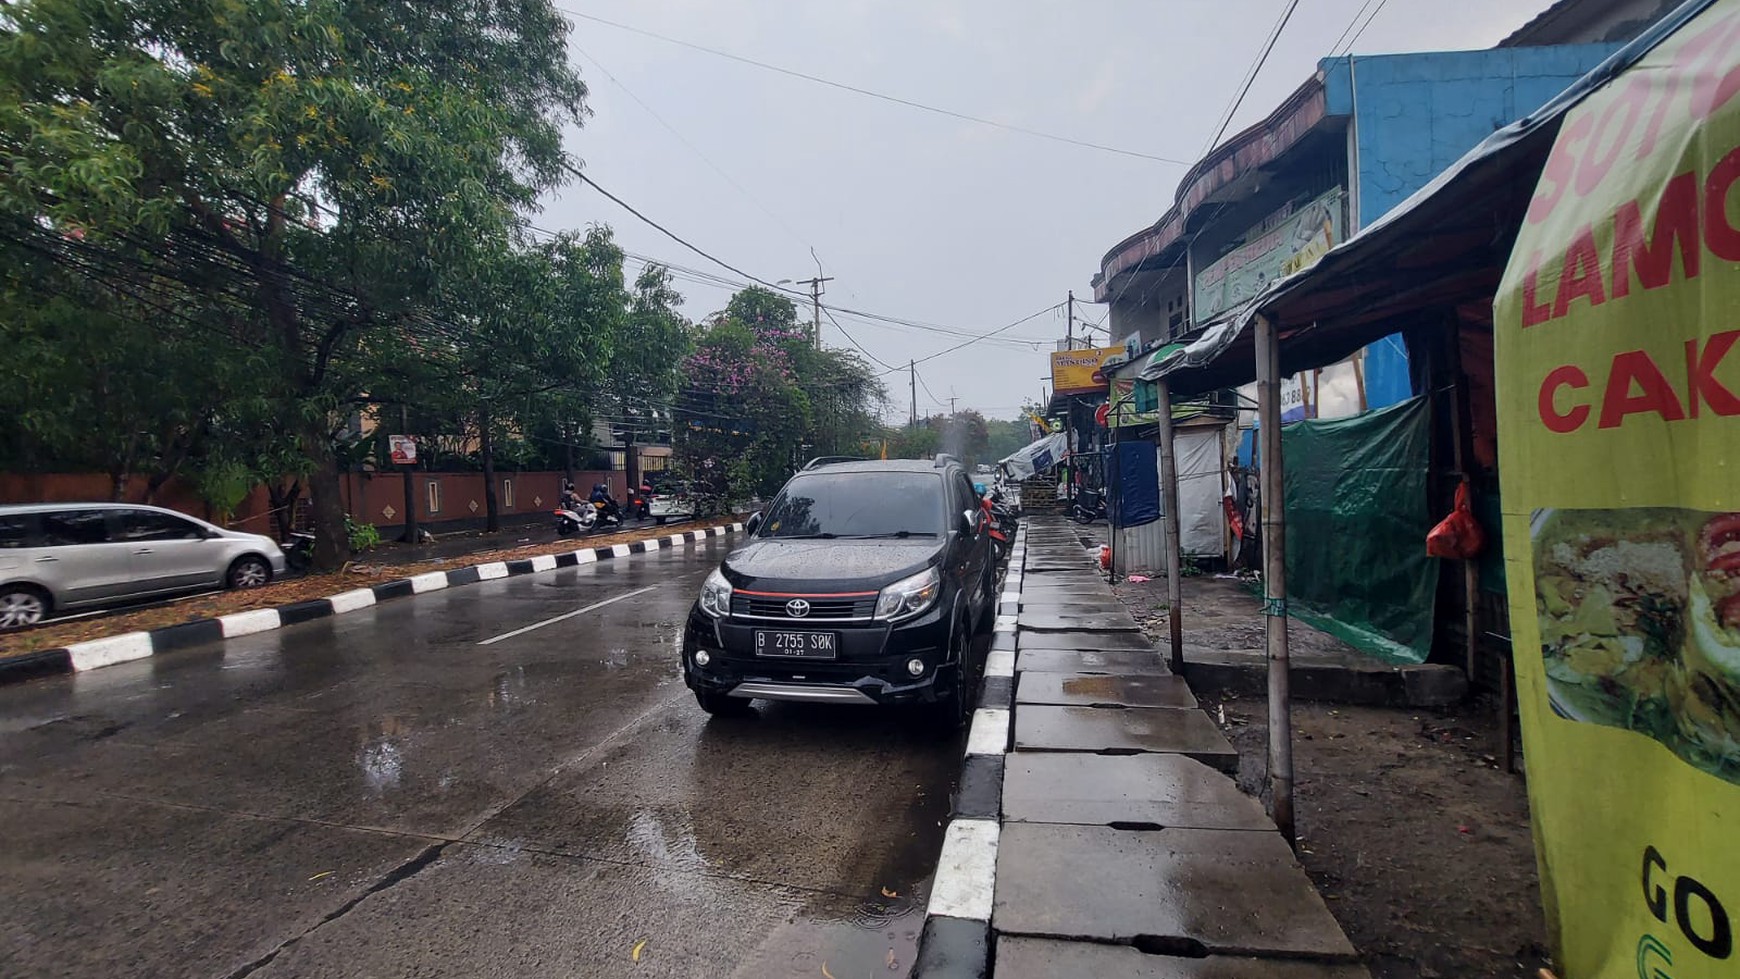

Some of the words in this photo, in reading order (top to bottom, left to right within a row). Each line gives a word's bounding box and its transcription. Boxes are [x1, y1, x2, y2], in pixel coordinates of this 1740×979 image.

[758, 632, 765, 647] B
[775, 633, 804, 648] 2755
[1643, 845, 1732, 959] GO
